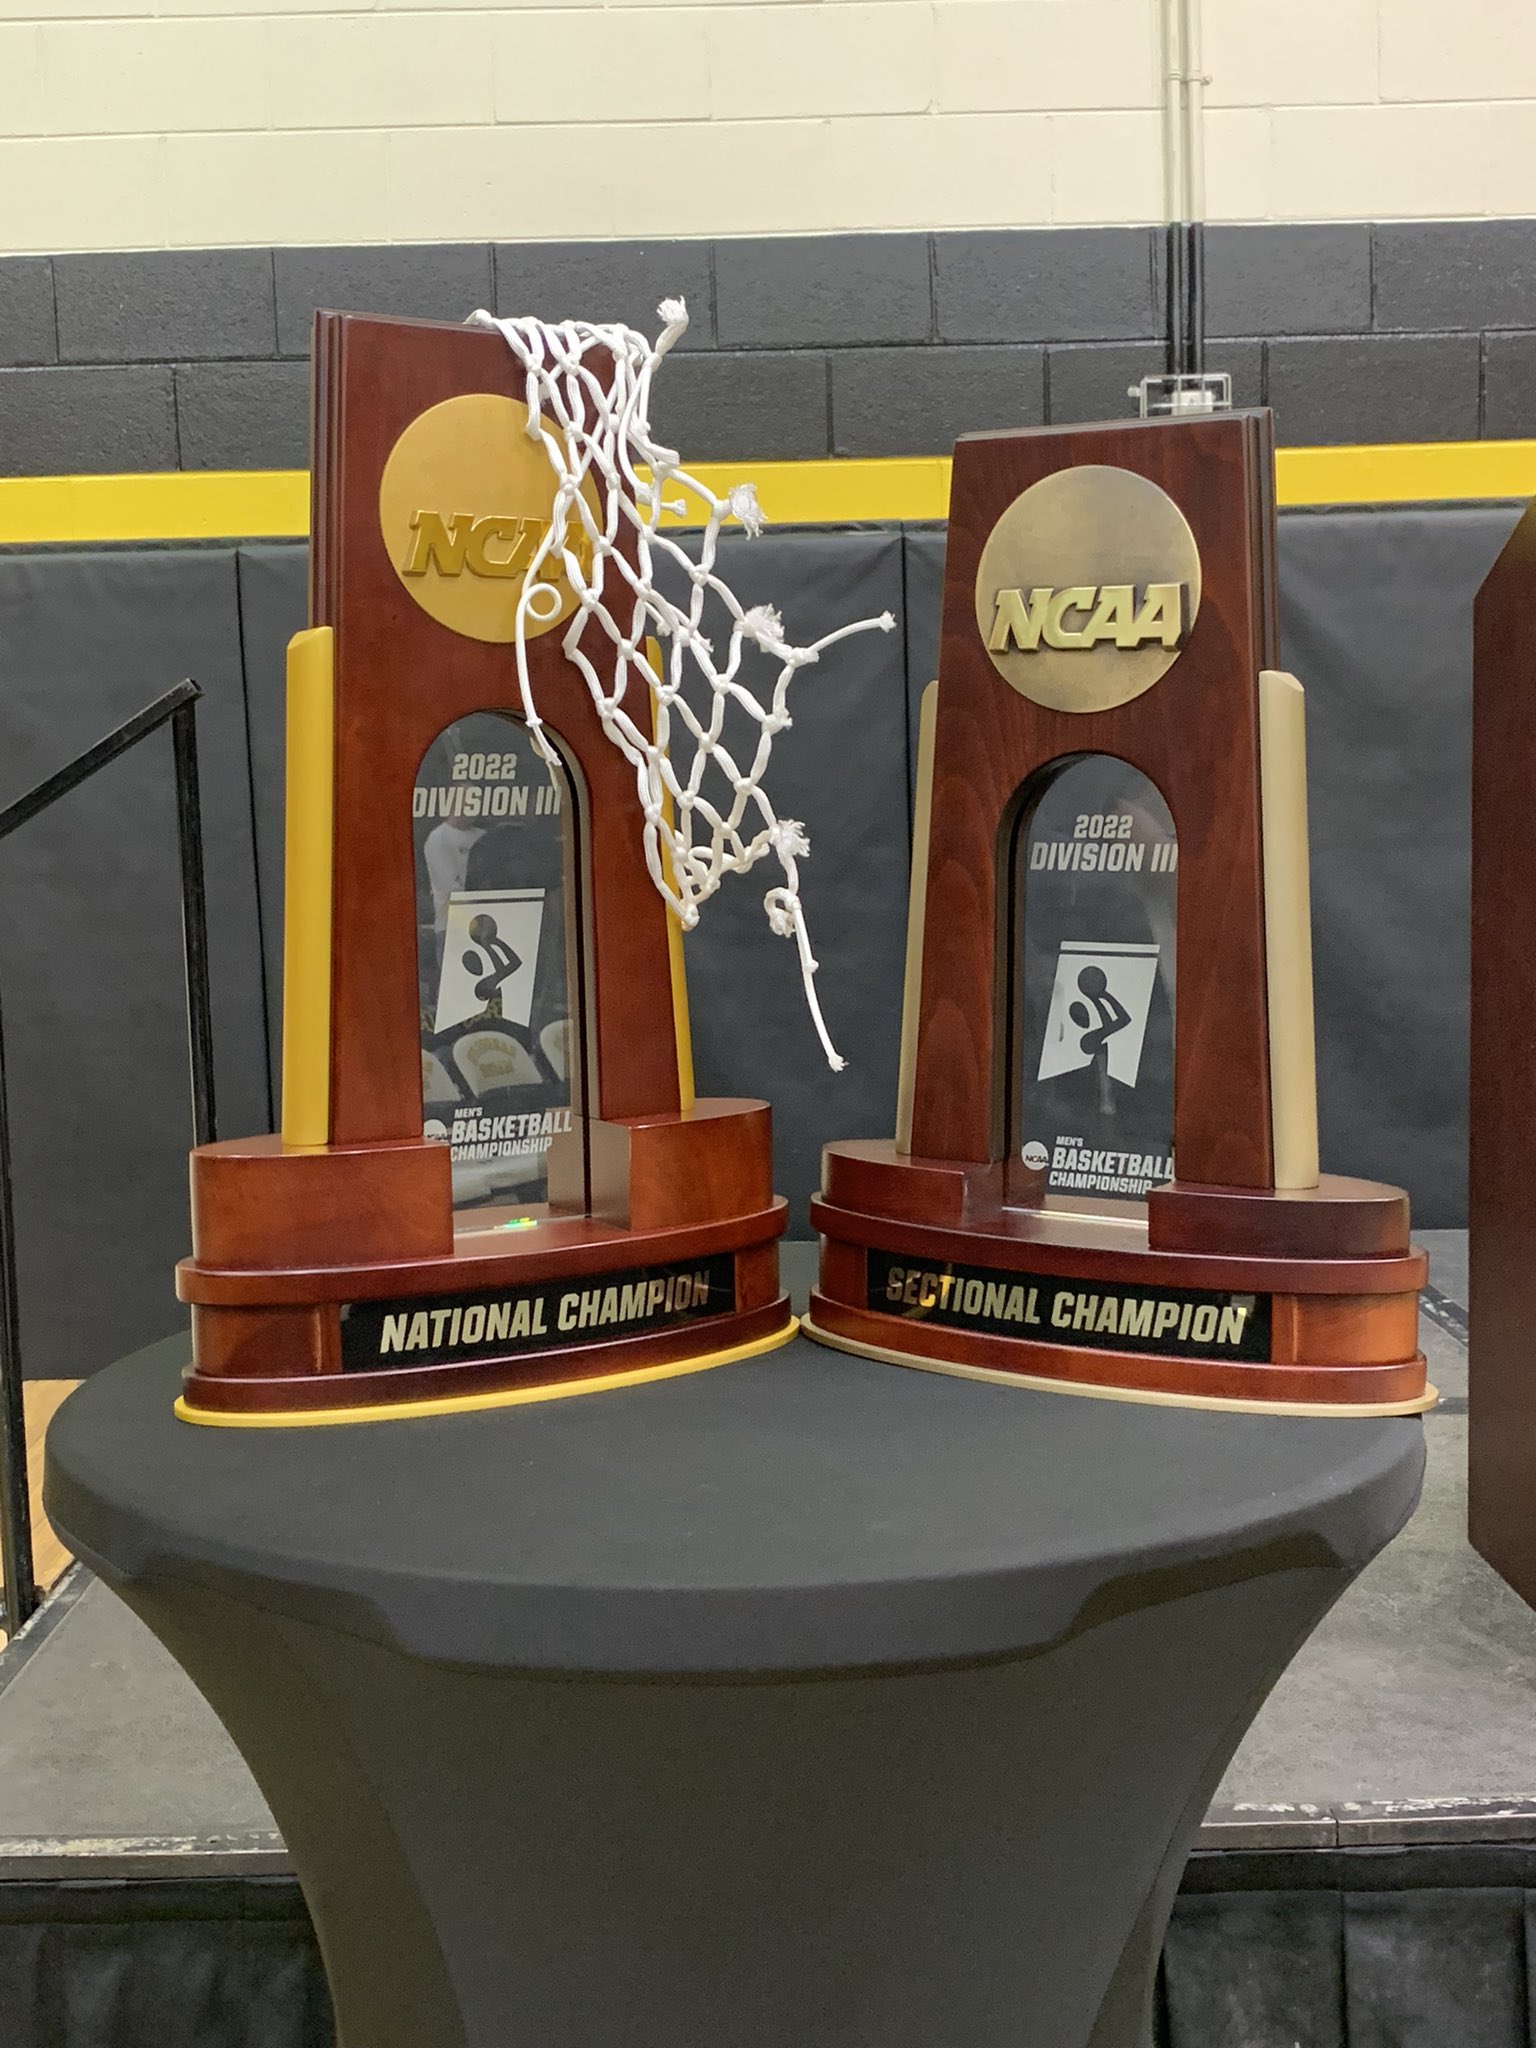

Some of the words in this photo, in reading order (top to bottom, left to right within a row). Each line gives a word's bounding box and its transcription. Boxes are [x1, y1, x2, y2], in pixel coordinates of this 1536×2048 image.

[989, 581, 1182, 654] NCAA
[452, 753, 517, 780] 2022
[412, 786, 528, 818] DIVISION
[535, 785, 562, 816] III
[1073, 814, 1134, 839] 2022
[1029, 841, 1145, 872] DIVISION
[1150, 843, 1179, 873] III
[451, 1110, 573, 1144] BASKETBALL
[454, 1107, 483, 1119] MEN'S
[451, 1136, 553, 1162] CHAMPIONSHIP
[1056, 1135, 1084, 1147] MEN'S
[1051, 1147, 1174, 1180] BASKETBALL
[1049, 1171, 1153, 1195] CHAMPIONSHIP
[380, 1299, 548, 1354] NATIONAL
[557, 1269, 711, 1332] CHAMPION
[886, 1267, 1041, 1325] SECTIONAL
[1051, 1291, 1246, 1345] CHAMPION
